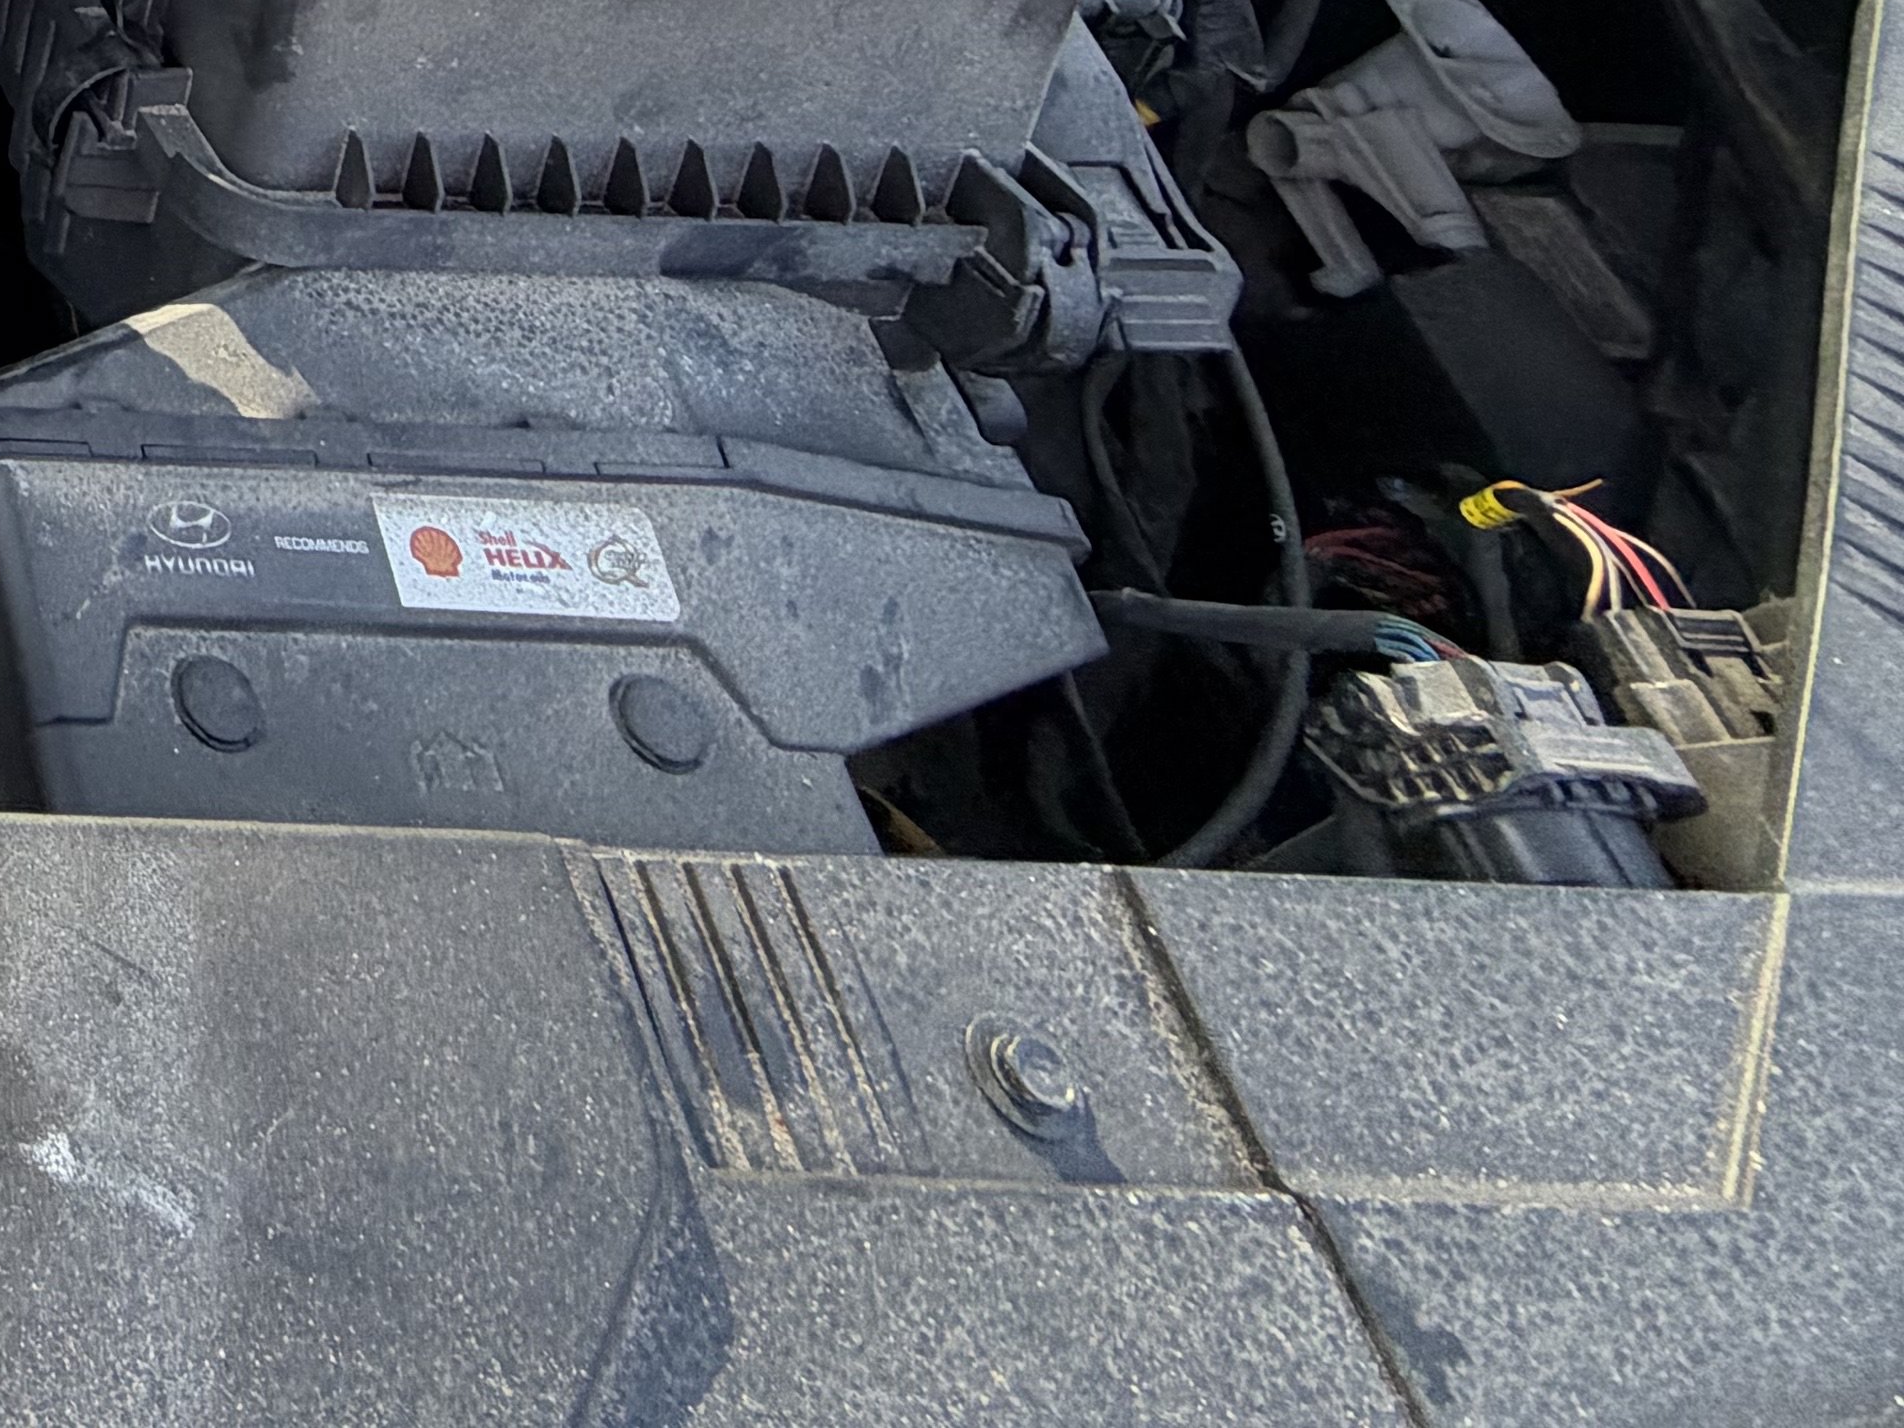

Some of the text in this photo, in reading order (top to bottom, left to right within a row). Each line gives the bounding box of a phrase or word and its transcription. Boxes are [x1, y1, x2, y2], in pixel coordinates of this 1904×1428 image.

[274, 535, 370, 555] RECOMMENDS
[478, 530, 517, 548] Shell
[144, 553, 256, 578] HYUNDAI
[483, 544, 573, 570] HELIX
